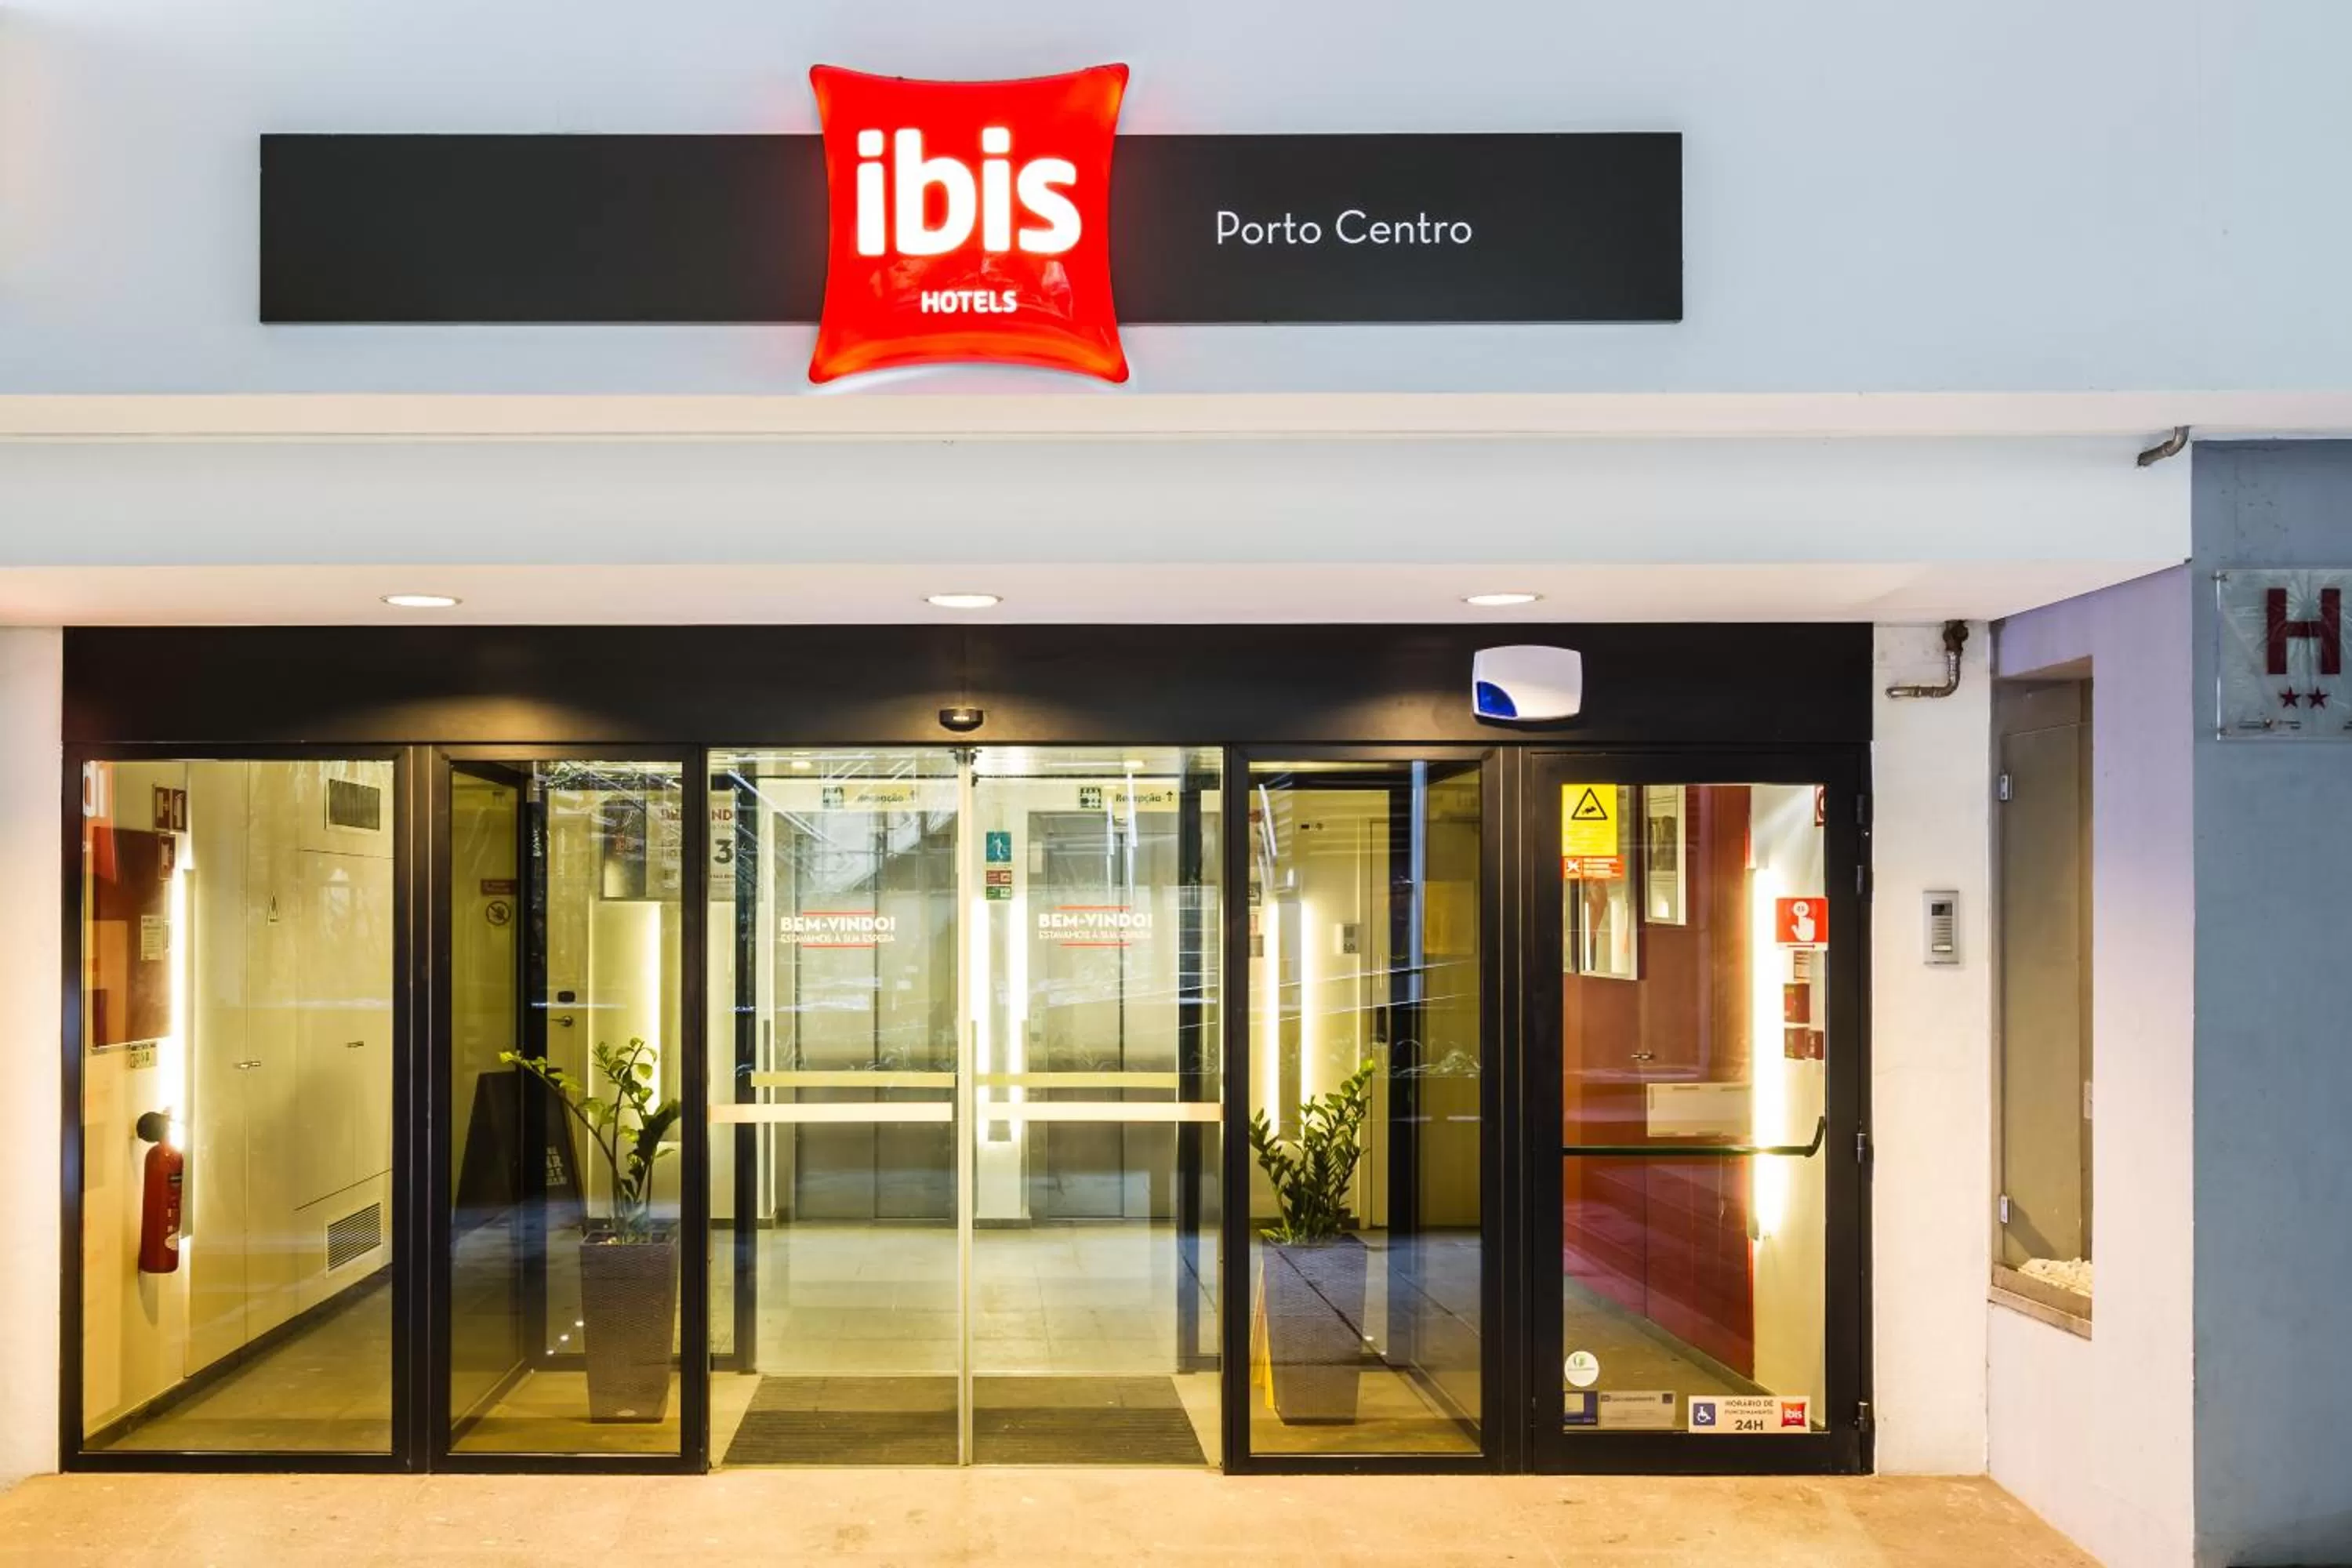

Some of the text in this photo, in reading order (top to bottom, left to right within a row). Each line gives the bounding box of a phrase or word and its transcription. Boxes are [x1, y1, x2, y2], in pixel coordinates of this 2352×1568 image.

[857, 127, 1081, 256] ibis
[1218, 209, 1472, 245] Porto Centro
[920, 289, 1018, 314] HOTELS
[2267, 588, 2341, 675] H
[857, 793, 904, 804] Repção
[1116, 793, 1162, 804] Reepção
[780, 916, 896, 932] BEM-VINDO!
[1038, 913, 1153, 928] BEM-VINDO!
[1735, 1420, 1763, 1431] 24H
